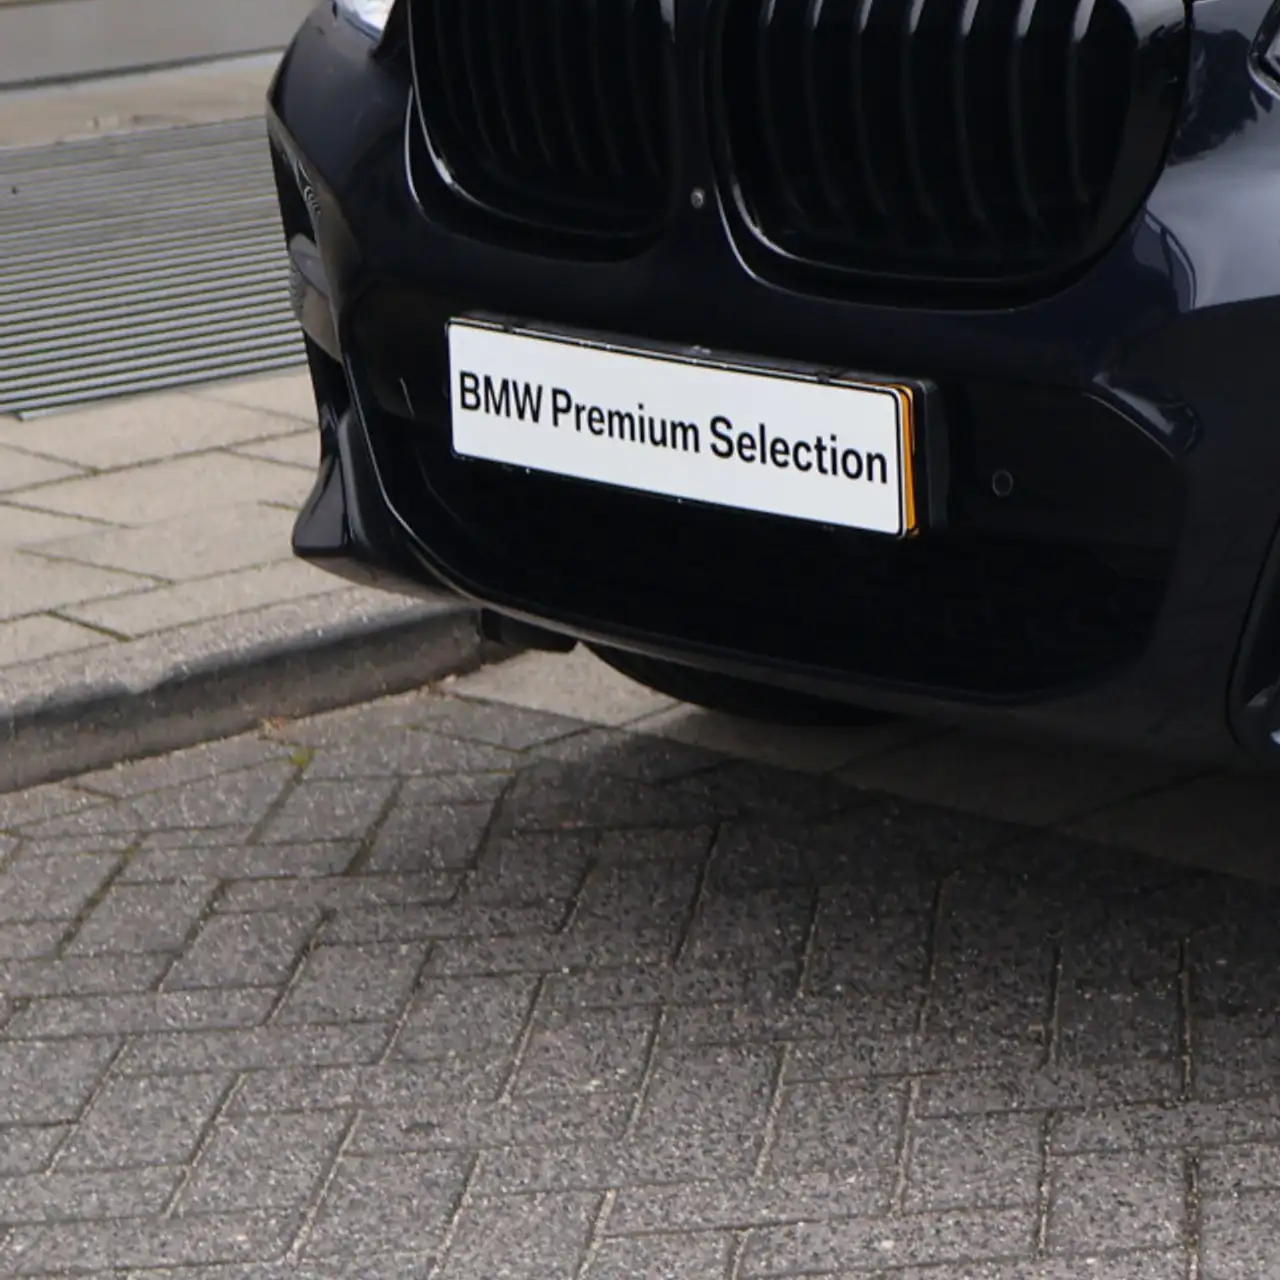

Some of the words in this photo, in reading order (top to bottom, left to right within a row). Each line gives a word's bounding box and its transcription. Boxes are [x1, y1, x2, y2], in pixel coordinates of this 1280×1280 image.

[459, 370, 543, 423] BMW
[551, 387, 701, 454] Premium
[709, 415, 889, 484] Selection
